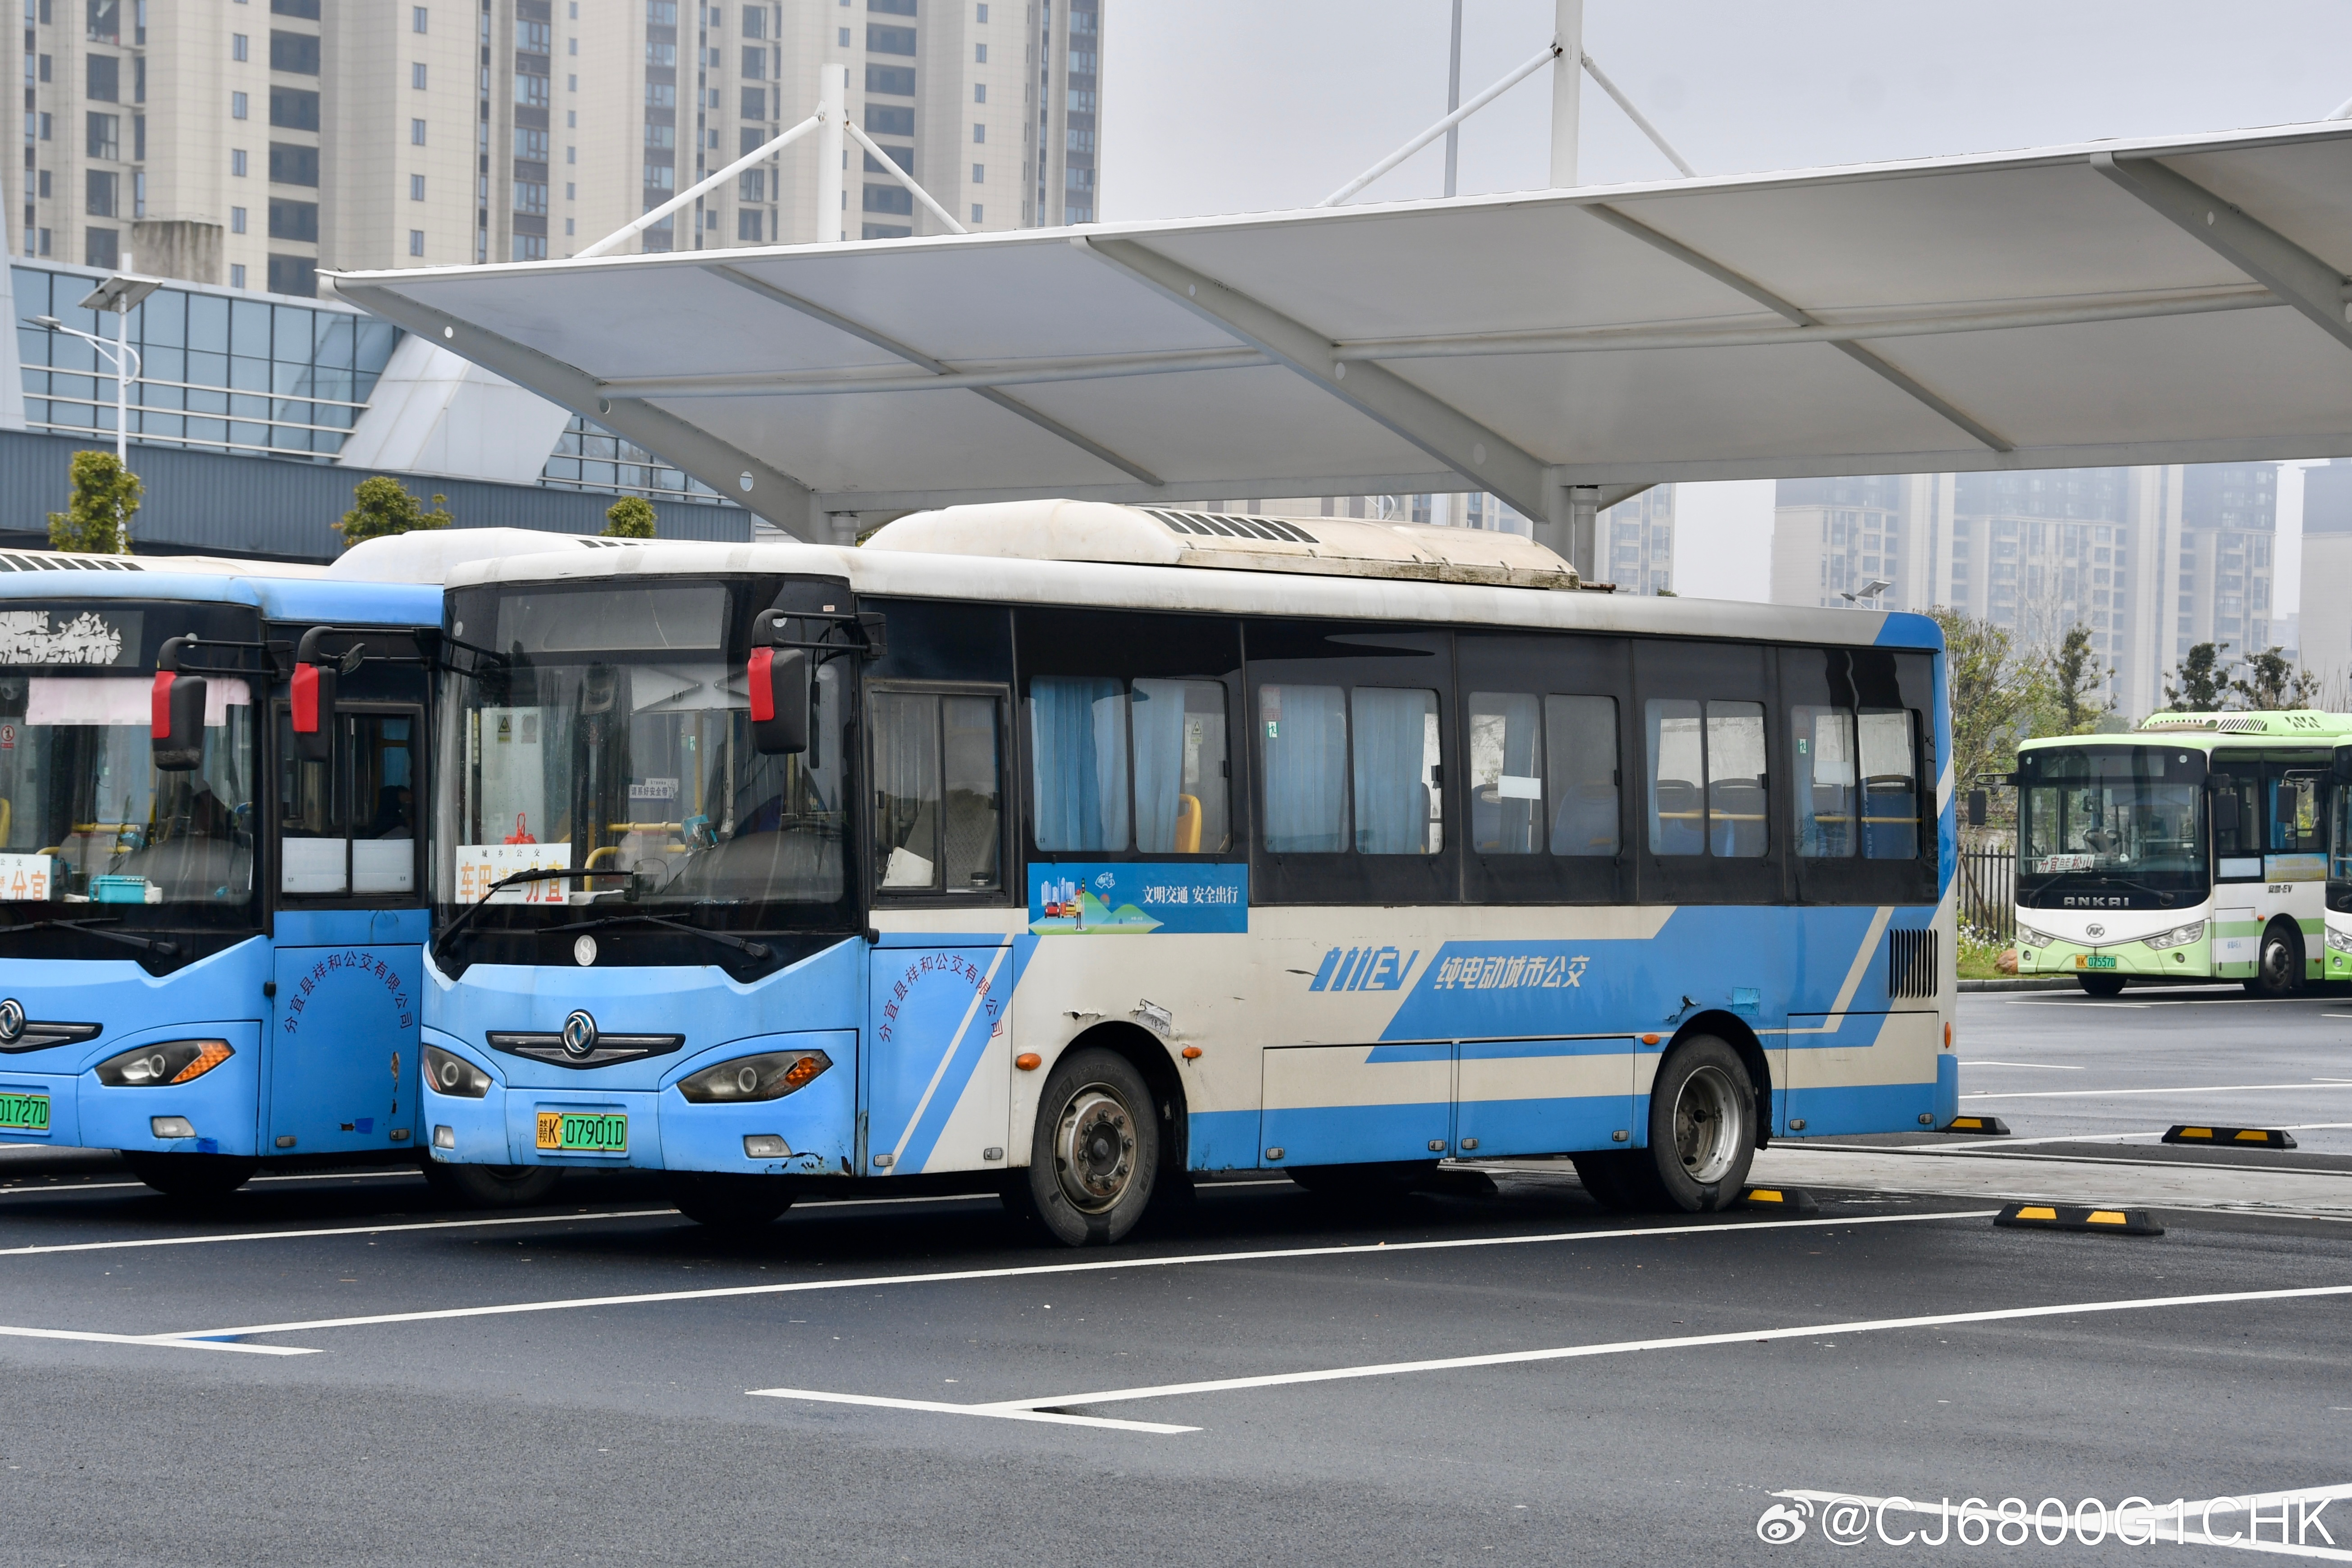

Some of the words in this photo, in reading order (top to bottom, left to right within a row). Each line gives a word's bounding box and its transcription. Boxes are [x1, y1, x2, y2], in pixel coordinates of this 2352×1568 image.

[1142, 886, 1188, 904] 文明交通
[1192, 886, 1238, 904] 安全出行
[2064, 897, 2129, 906] ANKAI
[580, 939, 591, 961] 8
[1434, 956, 1590, 990] 纯电动城市公交
[284, 951, 412, 1033] 分宜县祥和公交有限公司
[879, 952, 1003, 1042] 分宜县祥和公交有限公司
